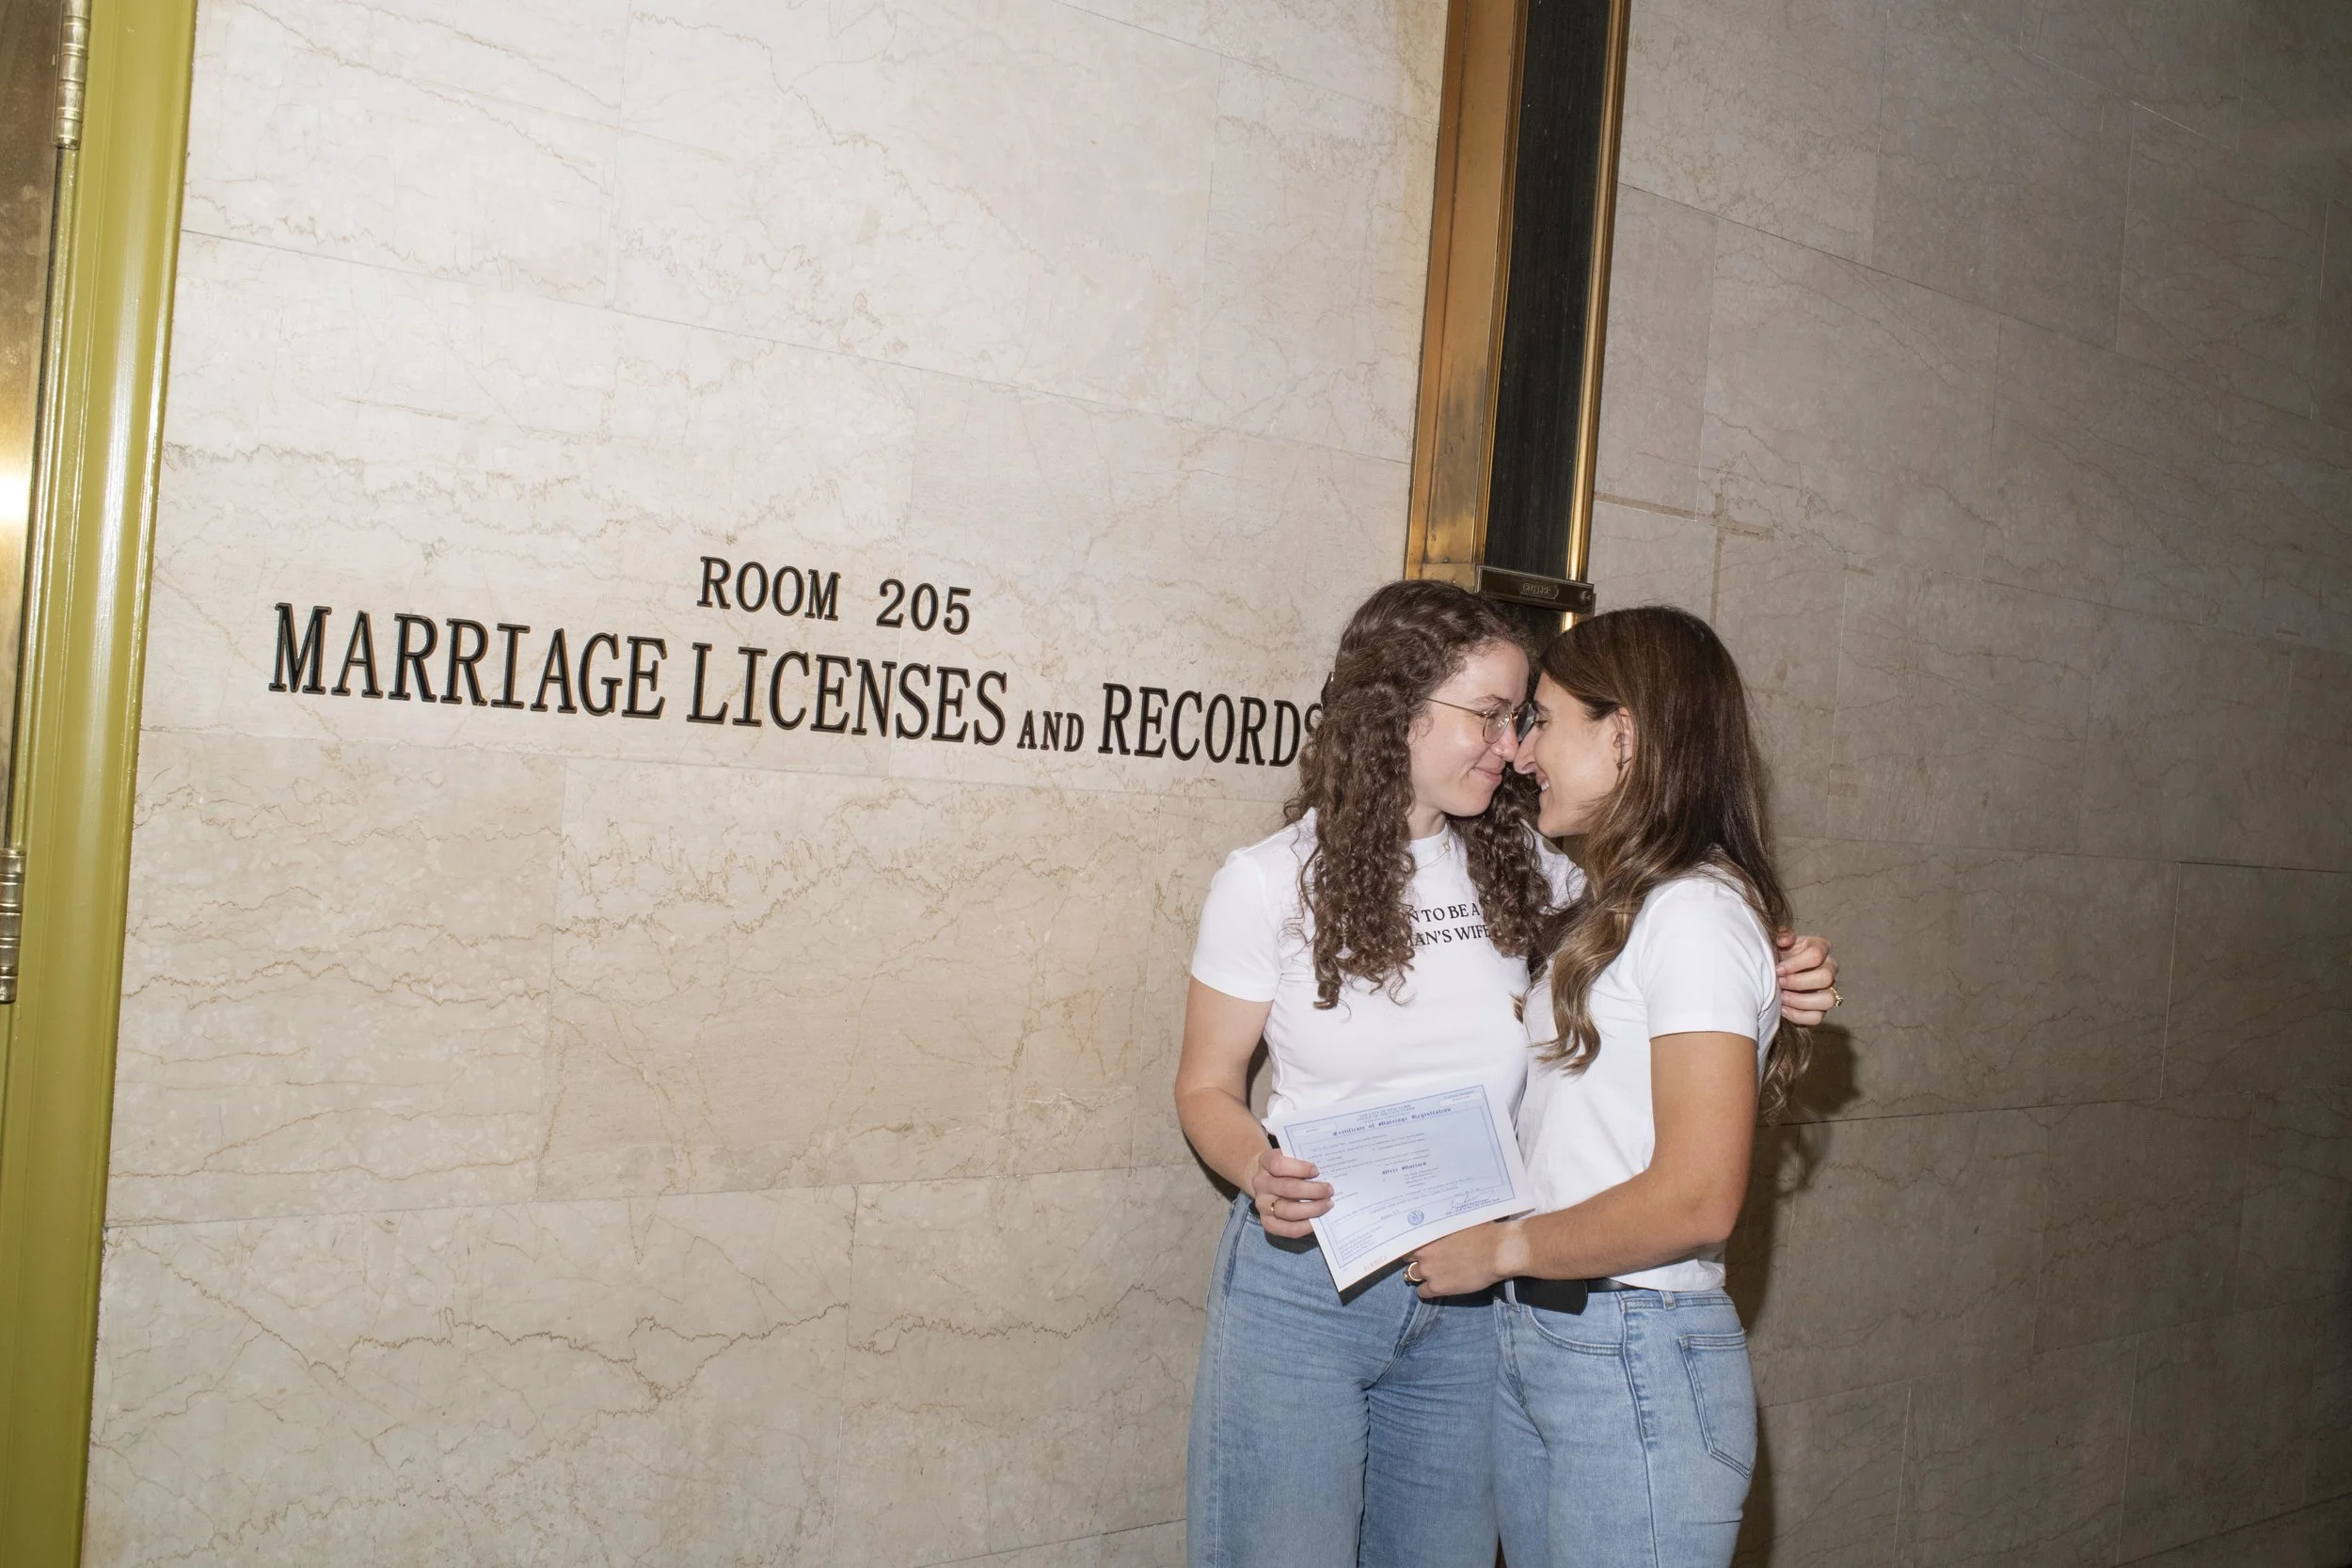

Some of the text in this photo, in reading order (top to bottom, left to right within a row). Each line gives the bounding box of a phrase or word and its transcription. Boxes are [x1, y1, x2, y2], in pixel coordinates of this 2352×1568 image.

[697, 556, 972, 635] ROOM 205
[268, 602, 668, 719] MARRIAGE
[686, 642, 1008, 745] LICENSES
[1016, 709, 1085, 752] AND
[1422, 908, 1445, 922] TO
[1447, 904, 1470, 919] BE
[1471, 902, 1481, 916] A
[1454, 924, 1490, 941] WIFE
